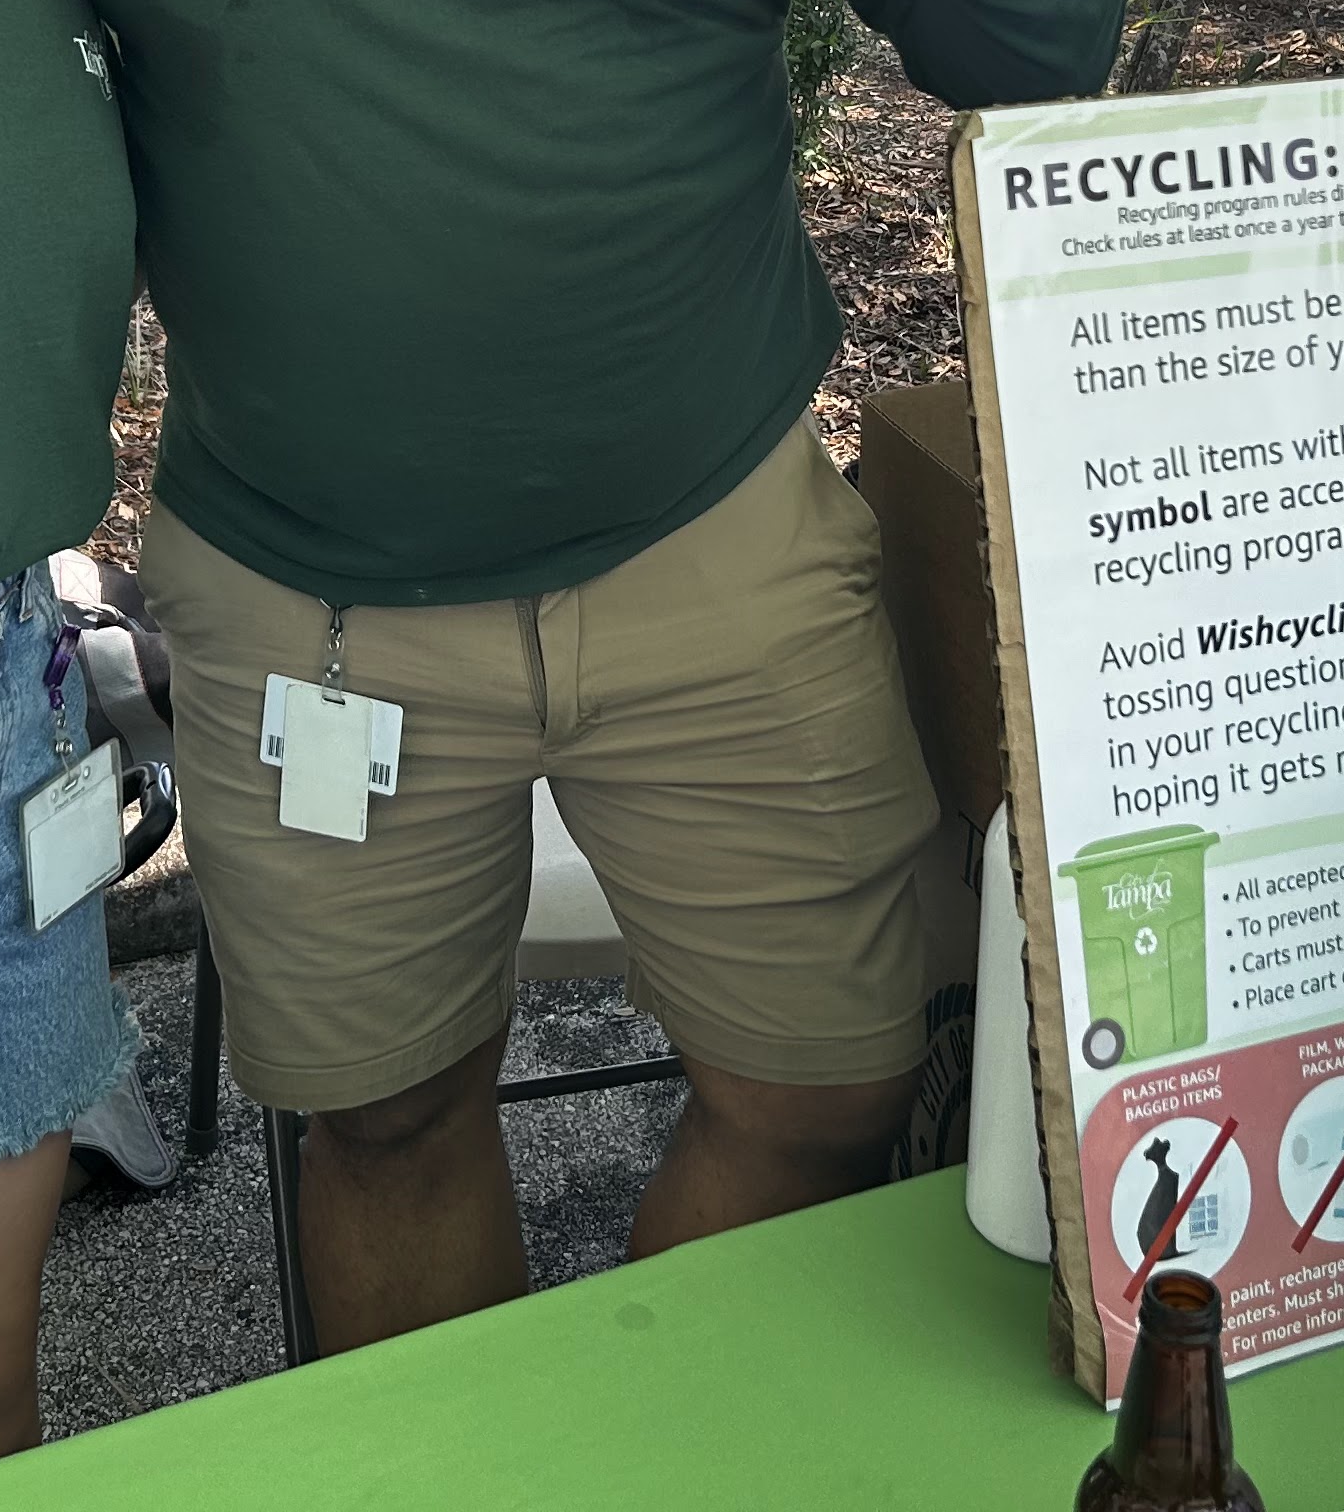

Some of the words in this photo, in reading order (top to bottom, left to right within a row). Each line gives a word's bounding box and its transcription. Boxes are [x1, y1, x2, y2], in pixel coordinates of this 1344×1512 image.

[1005, 138, 1337, 210] RECYCLING:
[1117, 201, 1200, 225] Recycling
[1203, 195, 1278, 219] program
[1283, 187, 1327, 206] rules
[1061, 234, 1115, 256] Check
[1119, 230, 1162, 250] rules
[1188, 223, 1231, 242] least
[1234, 220, 1276, 237] once
[1296, 214, 1334, 235] year
[1121, 309, 1206, 340] items
[1216, 295, 1294, 329] must
[1073, 361, 1146, 394] than
[1155, 351, 1207, 383] the
[1217, 344, 1275, 376] size
[1084, 456, 1141, 490] Not
[1198, 441, 1282, 474] items
[1089, 490, 1212, 543] symbol
[1094, 541, 1231, 586] recycling
[1100, 627, 1184, 672] Avoid
[1103, 679, 1212, 719] tossing
[1145, 726, 1213, 769] your
[1113, 774, 1218, 816] hoping
[1260, 752, 1325, 794] gets
[1267, 899, 1340, 936] prevent
[1242, 948, 1290, 972] Carts
[1296, 934, 1343, 960] must
[1245, 983, 1294, 1008] Place
[1300, 971, 1336, 994] cart
[1299, 1040, 1331, 1059] FILM,
[1122, 1076, 1176, 1102] PLASTIC
[1180, 1064, 1220, 1087] BAGS/
[1125, 1096, 1179, 1122] BAGGED
[1182, 1084, 1222, 1106] ITEMS
[1230, 1278, 1274, 1308] paint,
[1284, 1288, 1322, 1312] Must
[1232, 1335, 1257, 1353] For
[1262, 1324, 1302, 1344] more
